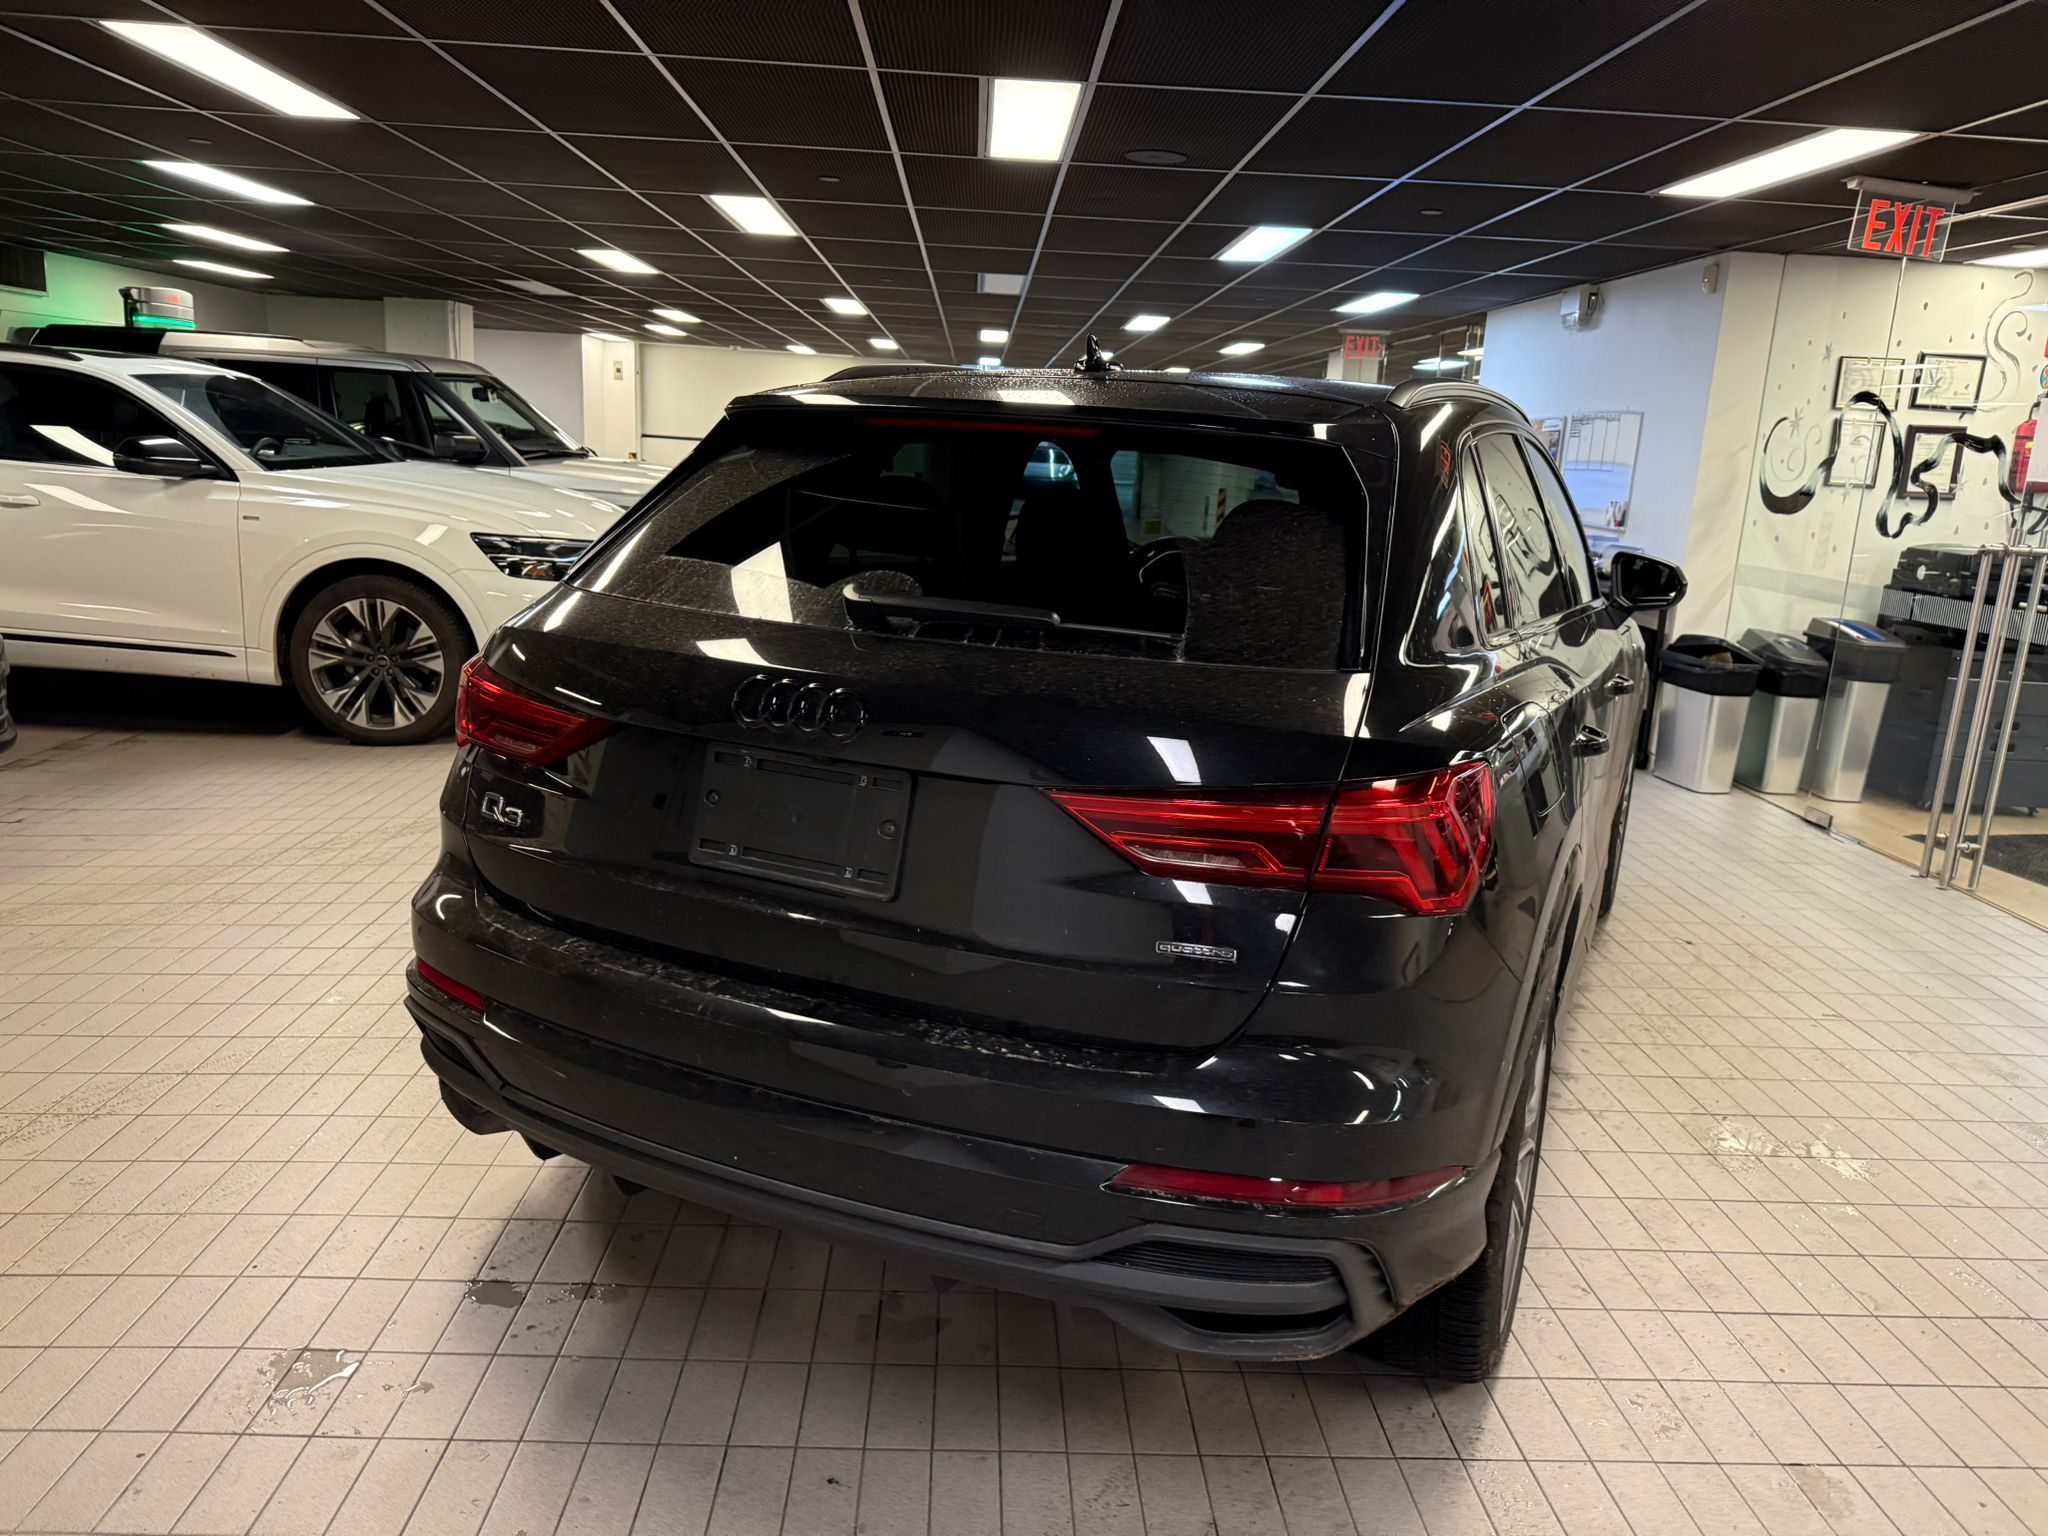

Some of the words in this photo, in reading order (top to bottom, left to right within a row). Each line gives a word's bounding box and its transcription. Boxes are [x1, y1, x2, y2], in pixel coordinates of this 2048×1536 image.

[1861, 198, 1946, 257] EXIT
[1343, 335, 1380, 358] EXIT
[480, 791, 524, 827] Q3
[1158, 943, 1234, 959] quattro
